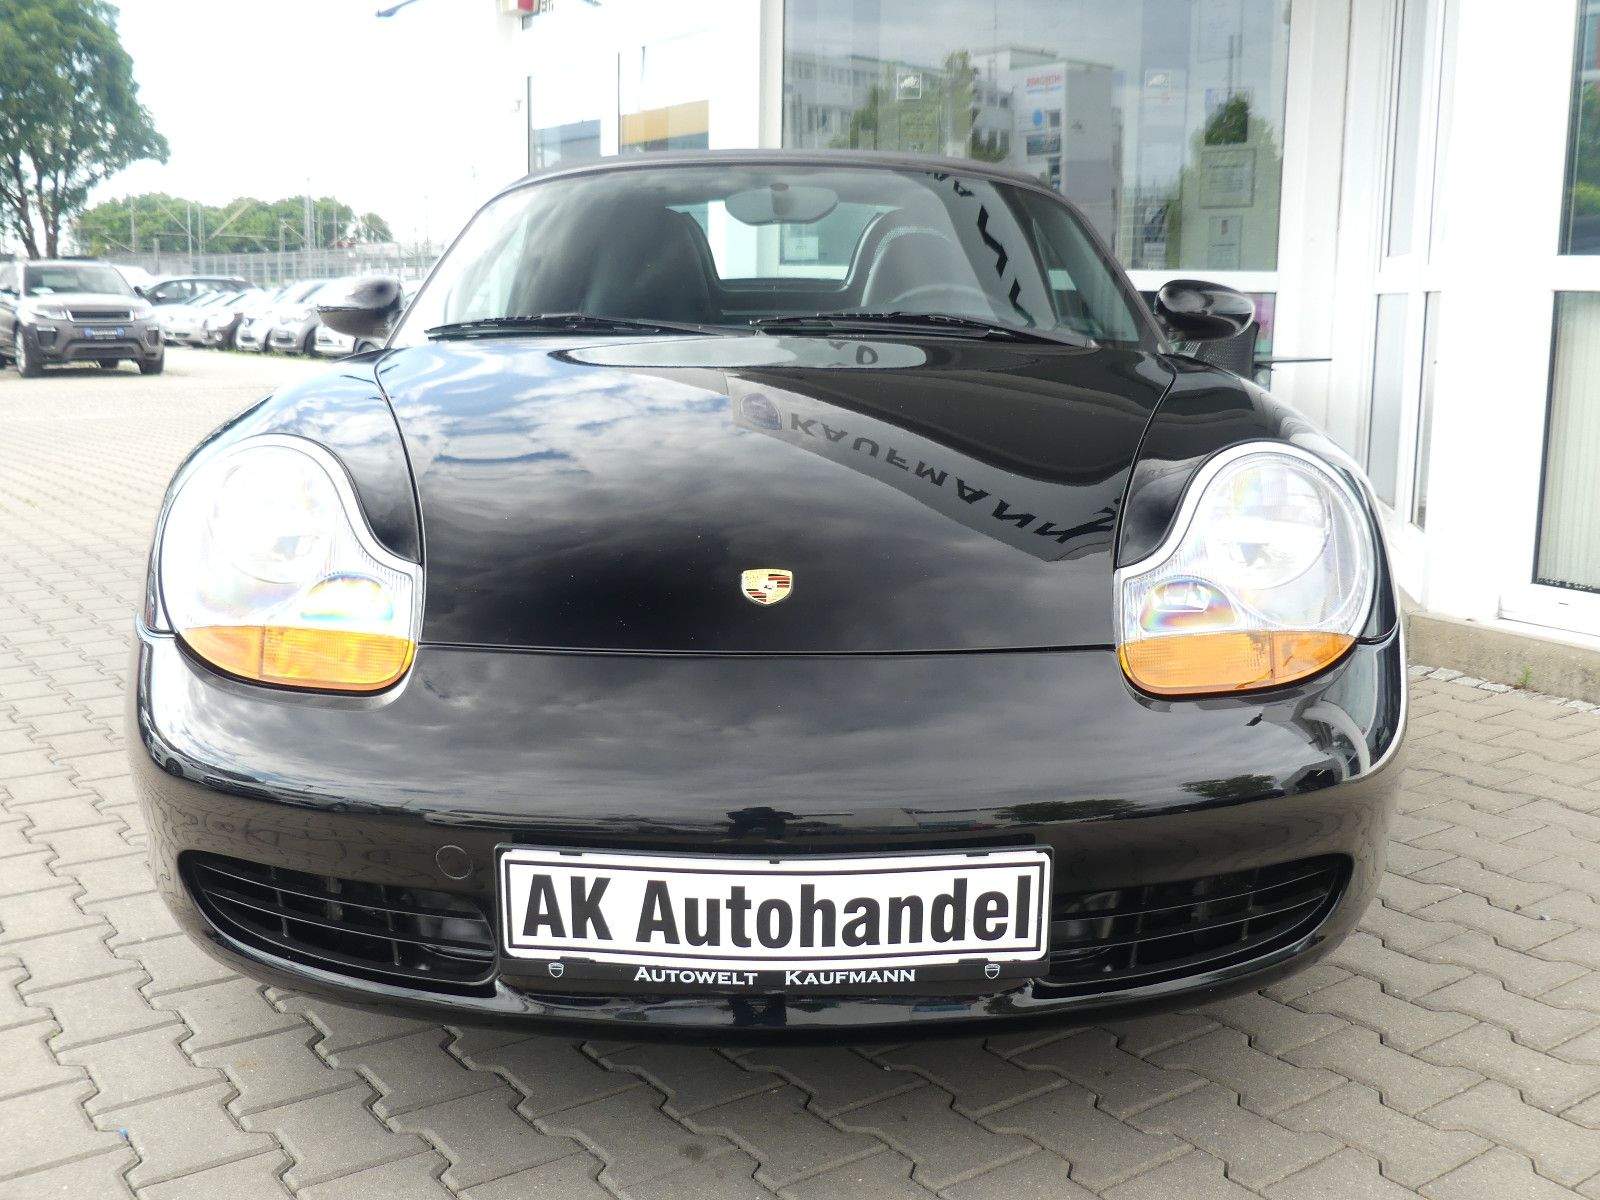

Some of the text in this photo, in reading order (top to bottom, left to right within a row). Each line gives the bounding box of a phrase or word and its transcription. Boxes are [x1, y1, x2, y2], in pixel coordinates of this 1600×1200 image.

[522, 874, 1031, 949] AK Autohandel
[634, 966, 915, 985] AUTOWELT KAUFMANN
